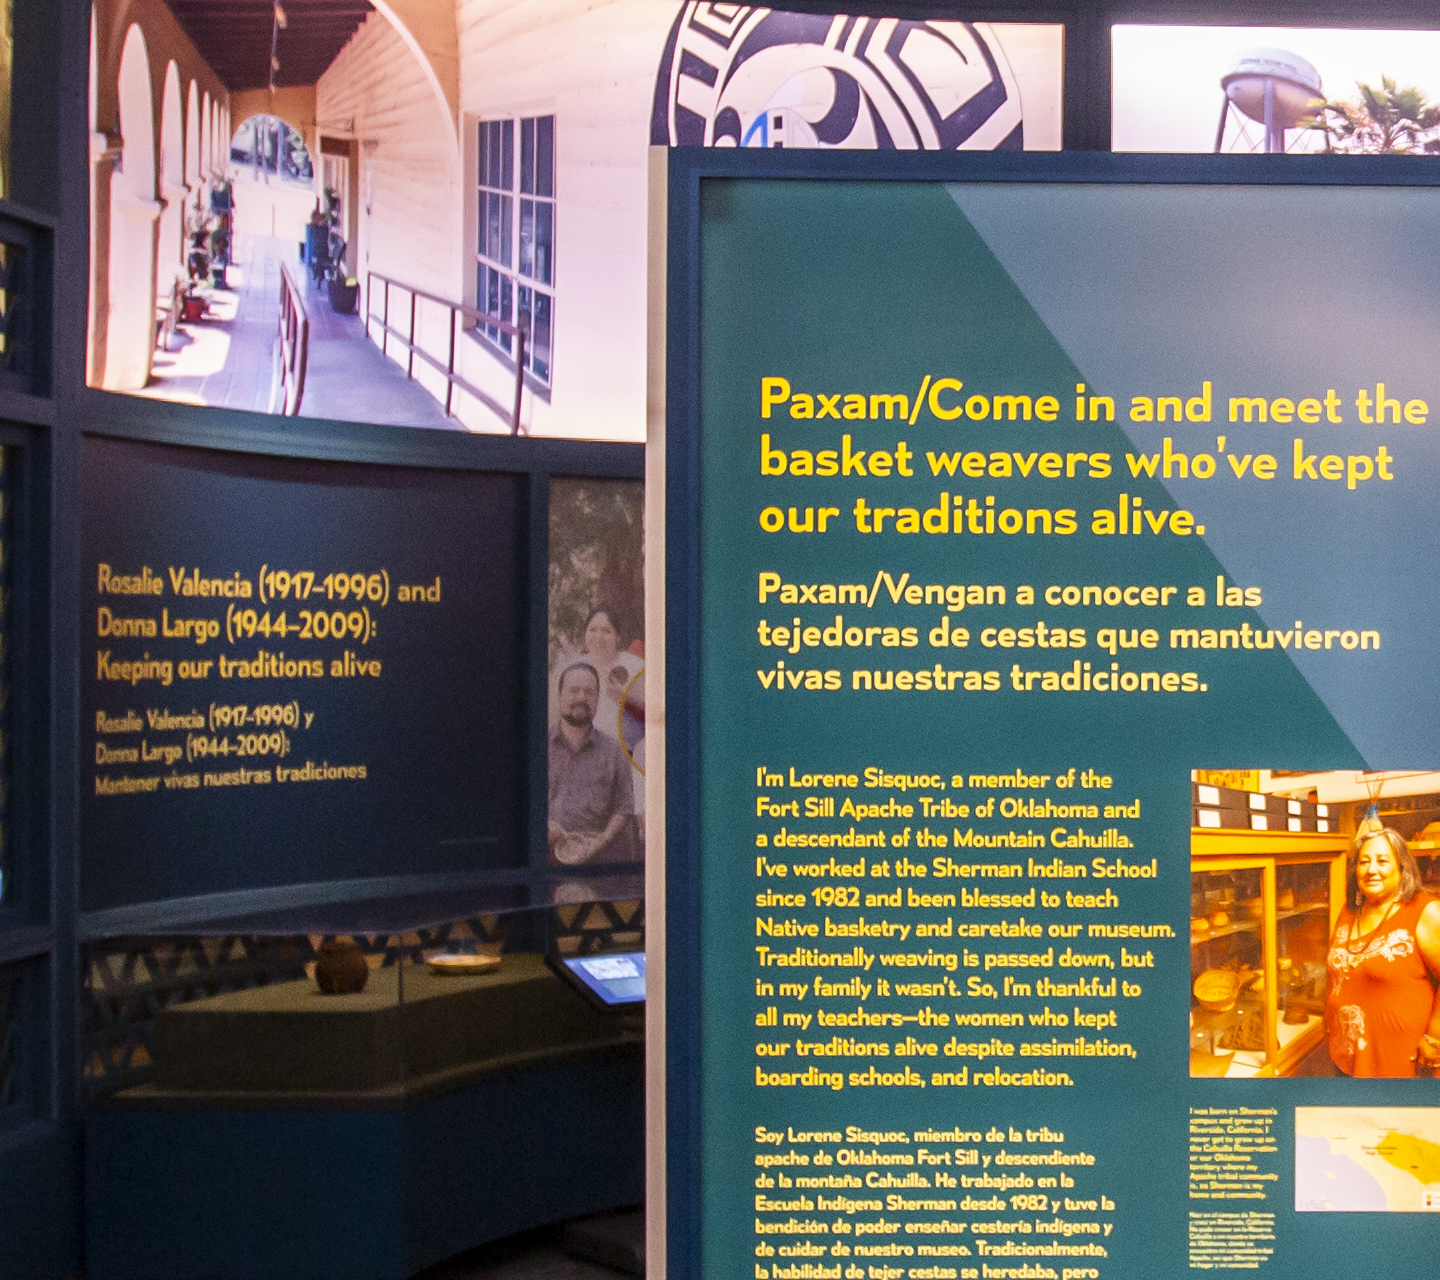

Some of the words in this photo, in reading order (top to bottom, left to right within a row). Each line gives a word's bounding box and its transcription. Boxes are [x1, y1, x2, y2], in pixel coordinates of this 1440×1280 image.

[761, 375, 1060, 425] Paxam/Come
[1075, 383, 1114, 421] in
[1129, 380, 1212, 422] and
[1228, 389, 1342, 423] meet
[1356, 382, 1428, 424] the
[760, 433, 913, 477] basket
[925, 451, 1112, 478] weavers
[1124, 435, 1277, 480] who've
[1293, 438, 1393, 489] kept
[758, 505, 839, 533] our
[852, 491, 1078, 535] traditions
[1090, 493, 1205, 536] alive.
[98, 562, 164, 595] Rosalie
[168, 566, 252, 597] Valencia
[397, 576, 440, 601] and
[757, 570, 1006, 613] Paxam/Vengan
[1014, 584, 1035, 606] a
[1043, 584, 1178, 607] conocer
[1186, 585, 1206, 607] a
[1215, 574, 1263, 607] las
[98, 606, 157, 636] Donna
[162, 608, 220, 644] Largo
[756, 613, 919, 654] tejedoras
[928, 614, 971, 648] de
[979, 620, 1087, 649] cestas
[1095, 627, 1160, 656] que
[1169, 619, 1381, 650] mantuvieron
[97, 651, 173, 686] Keeping
[177, 660, 213, 678] our
[218, 649, 324, 678] traditions
[330, 651, 381, 677] alive
[755, 659, 842, 691] vivas
[851, 662, 1001, 692] nuestras
[1009, 658, 1209, 693] tradiciones.
[275, 760, 367, 782] tradiciones
[756, 766, 784, 787] I'm
[788, 766, 859, 788] Lorene
[863, 766, 945, 791] Sisquoc,
[950, 774, 963, 788] a
[968, 768, 1051, 789] member
[1055, 767, 1076, 789] of
[1079, 768, 1113, 789] the
[755, 795, 799, 817] Fort
[804, 796, 834, 817] Sill
[839, 797, 914, 821] Apache
[918, 796, 970, 818] Tribe
[974, 796, 995, 818] of
[999, 796, 1099, 818] Oklahoma
[1103, 798, 1140, 818] and
[755, 833, 768, 847] a
[772, 826, 886, 848] descendant
[890, 826, 911, 848] of
[915, 827, 948, 848] the
[952, 828, 1046, 848] Mountain
[1049, 826, 1134, 848] Cahuilla.
[755, 856, 788, 878] I've
[792, 856, 866, 877] worked
[869, 860, 890, 877] at
[894, 857, 927, 877] the
[932, 856, 1023, 878] Sherman
[1027, 857, 1087, 878] Indian
[1091, 856, 1157, 878] School
[755, 888, 806, 907] since
[810, 885, 860, 907] 1982
[864, 887, 902, 907] and
[906, 887, 956, 907] been
[960, 887, 1036, 908] blessed
[1040, 890, 1061, 907] to
[1065, 887, 1119, 908] teach
[755, 916, 819, 937] Native
[824, 916, 911, 940] basketry
[915, 917, 953, 937] and
[957, 917, 1043, 937] caretake
[1047, 924, 1083, 938] our
[1087, 923, 1176, 938] museum.
[755, 945, 875, 971] Traditionally
[879, 948, 958, 971] weaving
[962, 948, 979, 967] is
[983, 947, 1054, 971] passed
[1057, 947, 1115, 969] down,
[1120, 947, 1154, 967] but
[755, 978, 774, 996] in
[778, 982, 809, 1000] my
[812, 975, 872, 1000] family
[876, 978, 890, 997] it
[894, 975, 961, 997] wasn't.
[966, 975, 998, 998] So,
[1003, 976, 1032, 996] I'm
[1035, 976, 1117, 997] thankful
[1121, 980, 1142, 997] to
[755, 1006, 778, 1026] all
[782, 1012, 812, 1030] my
[954, 1012, 1024, 1027] women
[1028, 1006, 1069, 1027] who
[1073, 1006, 1117, 1030] kept
[755, 1042, 790, 1056] our
[795, 1035, 890, 1056] traditions
[893, 1036, 938, 1056] alive
[942, 1036, 1015, 1060] despite
[1019, 1036, 1137, 1058] assimilation,
[755, 1065, 844, 1090] boarding
[848, 1065, 926, 1087] schools,
[930, 1065, 968, 1086] and
[972, 1066, 1074, 1086] relocation.
[754, 1125, 785, 1146] Soy
[786, 1126, 842, 1143] Lorene
[845, 1125, 910, 1145] Sisquoc,
[913, 1126, 983, 1143] miembro
[984, 1125, 1006, 1143] de
[1007, 1126, 1024, 1143] la
[1024, 1126, 1065, 1143] tribu
